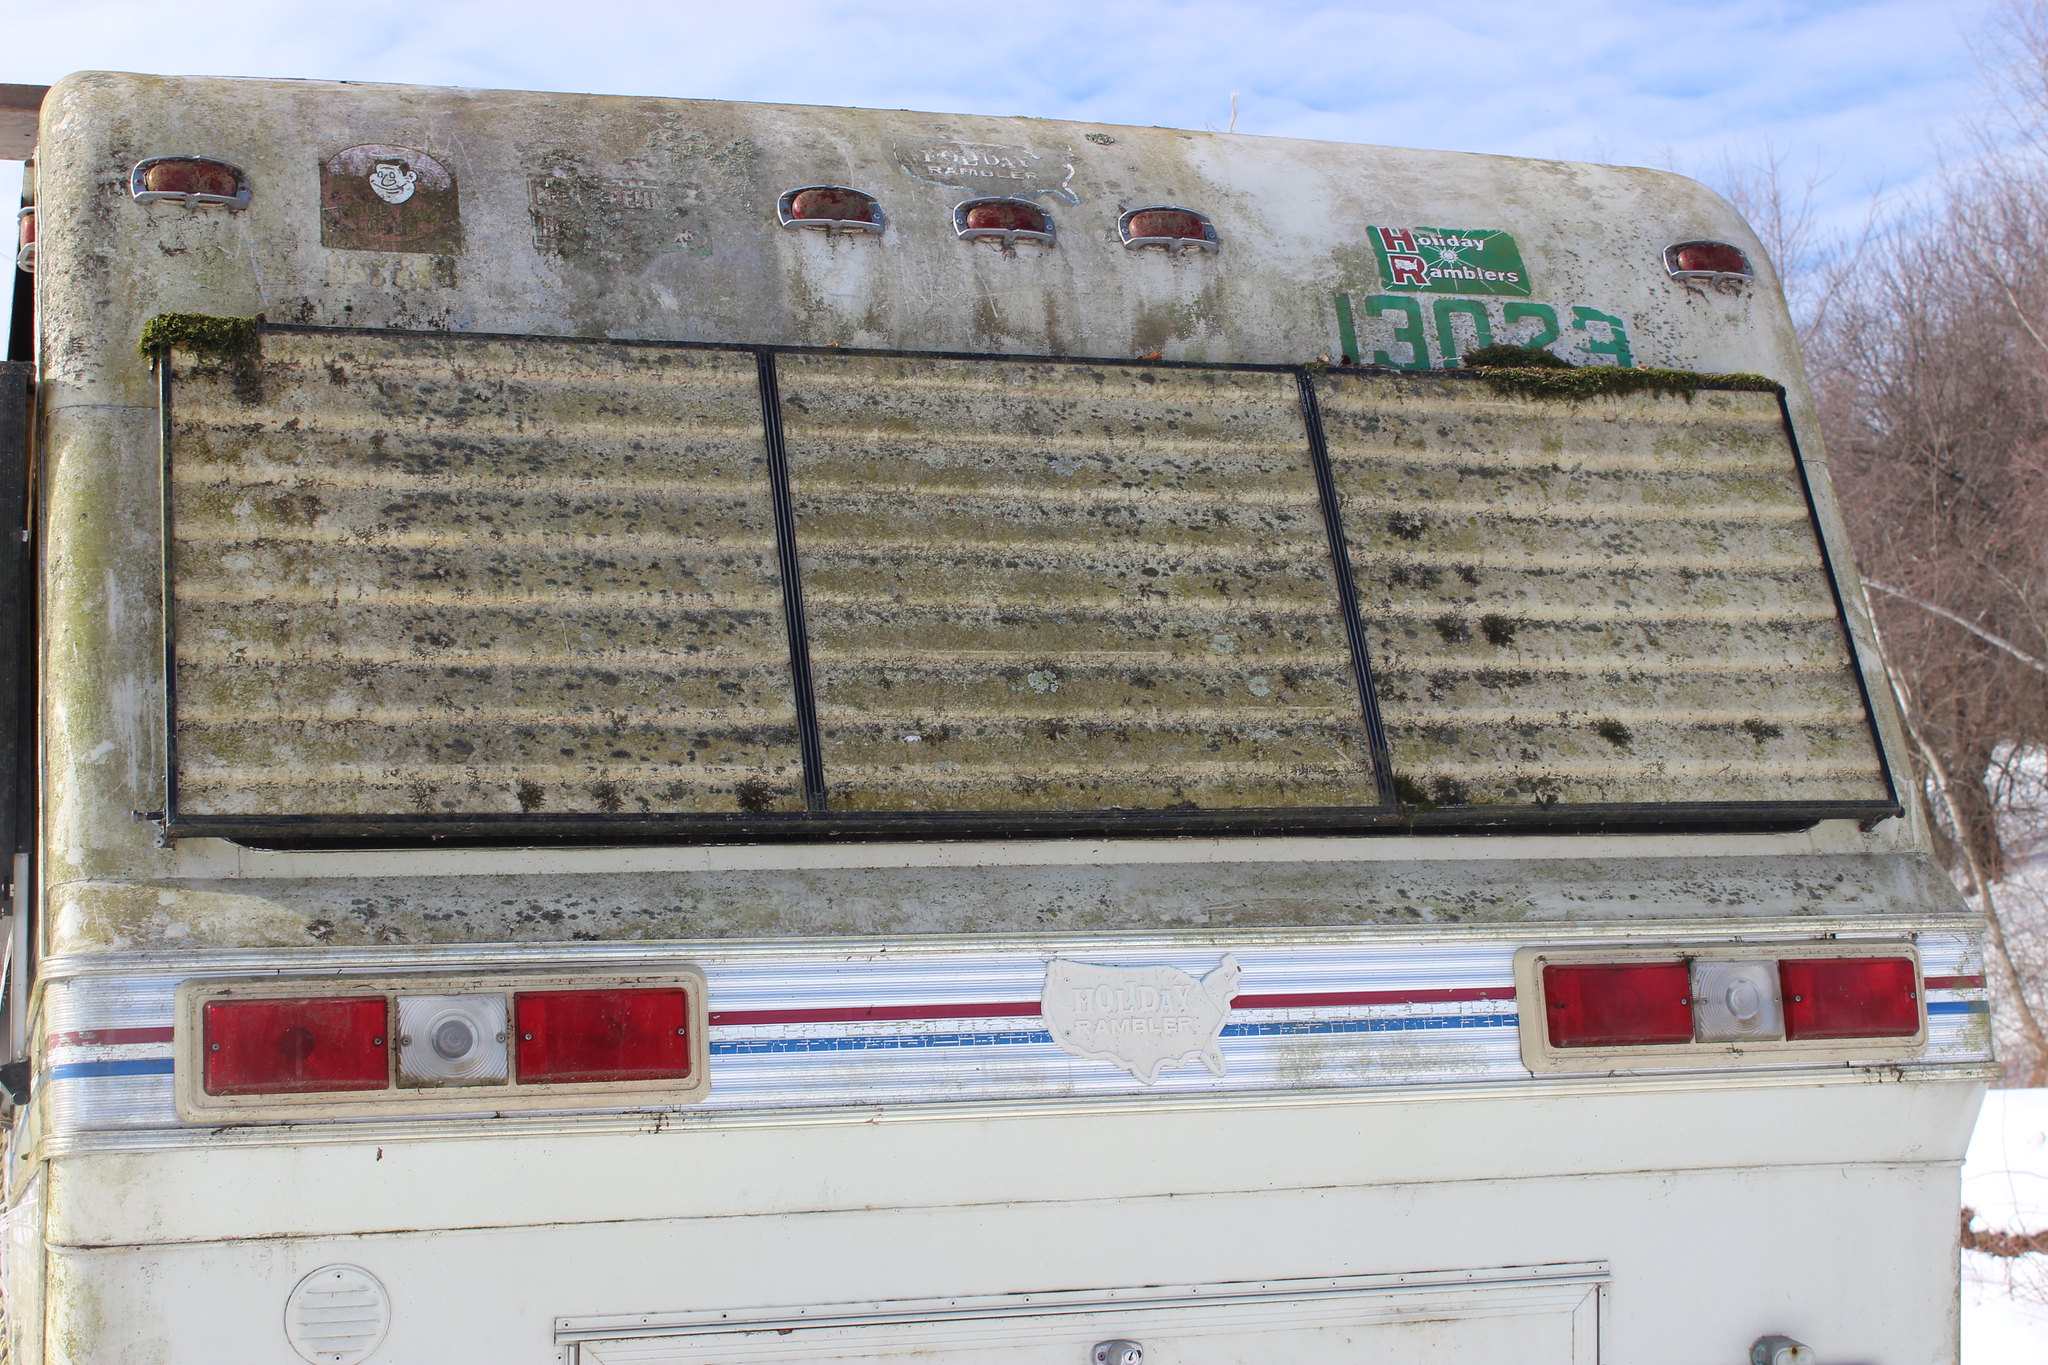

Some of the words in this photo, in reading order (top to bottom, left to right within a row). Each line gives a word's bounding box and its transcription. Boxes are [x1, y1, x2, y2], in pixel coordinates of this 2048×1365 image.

[1377, 226, 1485, 254] Holiday
[1388, 254, 1520, 287] Ramblers
[1072, 980, 1192, 1015] HOLIDAY
[1073, 1016, 1193, 1035] RAMBLER
